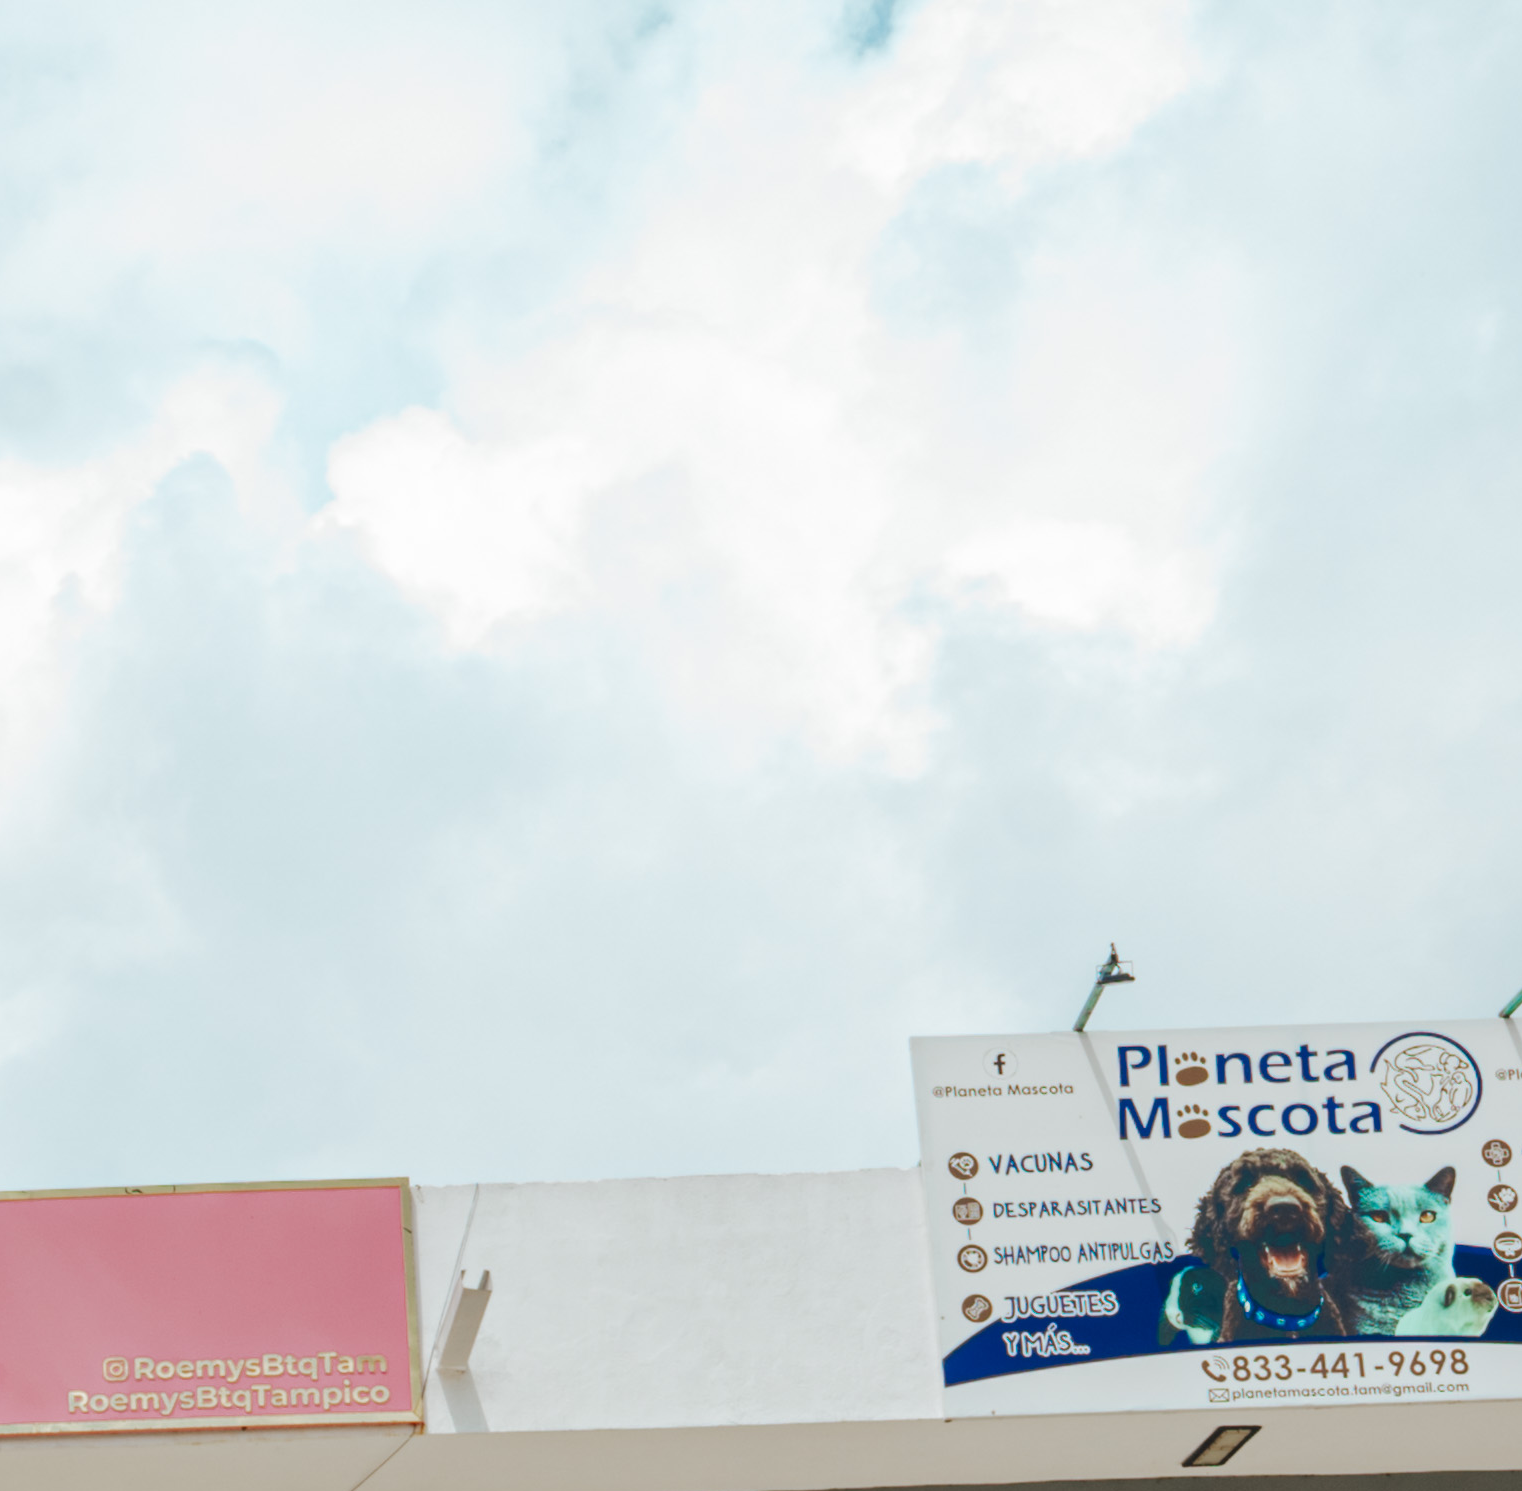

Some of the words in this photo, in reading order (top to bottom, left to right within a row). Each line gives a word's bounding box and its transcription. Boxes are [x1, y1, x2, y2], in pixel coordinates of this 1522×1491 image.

[932, 1084, 1003, 1099] @Planeta
[1007, 1082, 1074, 1097] Mascota
[989, 1152, 1094, 1175] VACUNAS
[992, 1198, 1163, 1219] DESPARASITANTES
[993, 1245, 1072, 1265] SHAMPOO
[1076, 1241, 1175, 1262] ANTIPULGAS
[1003, 1291, 1119, 1322] JUGUETES
[1002, 1331, 1020, 1357] Y
[1021, 1323, 1090, 1357] MÁS...
[134, 1351, 388, 1383] RoemysBtqTam
[1232, 1348, 1470, 1382] 833-441-9698
[68, 1379, 391, 1415] RoemysBtqTampico
[1232, 1382, 1470, 1402] planetamascota.tam@gmail.com
